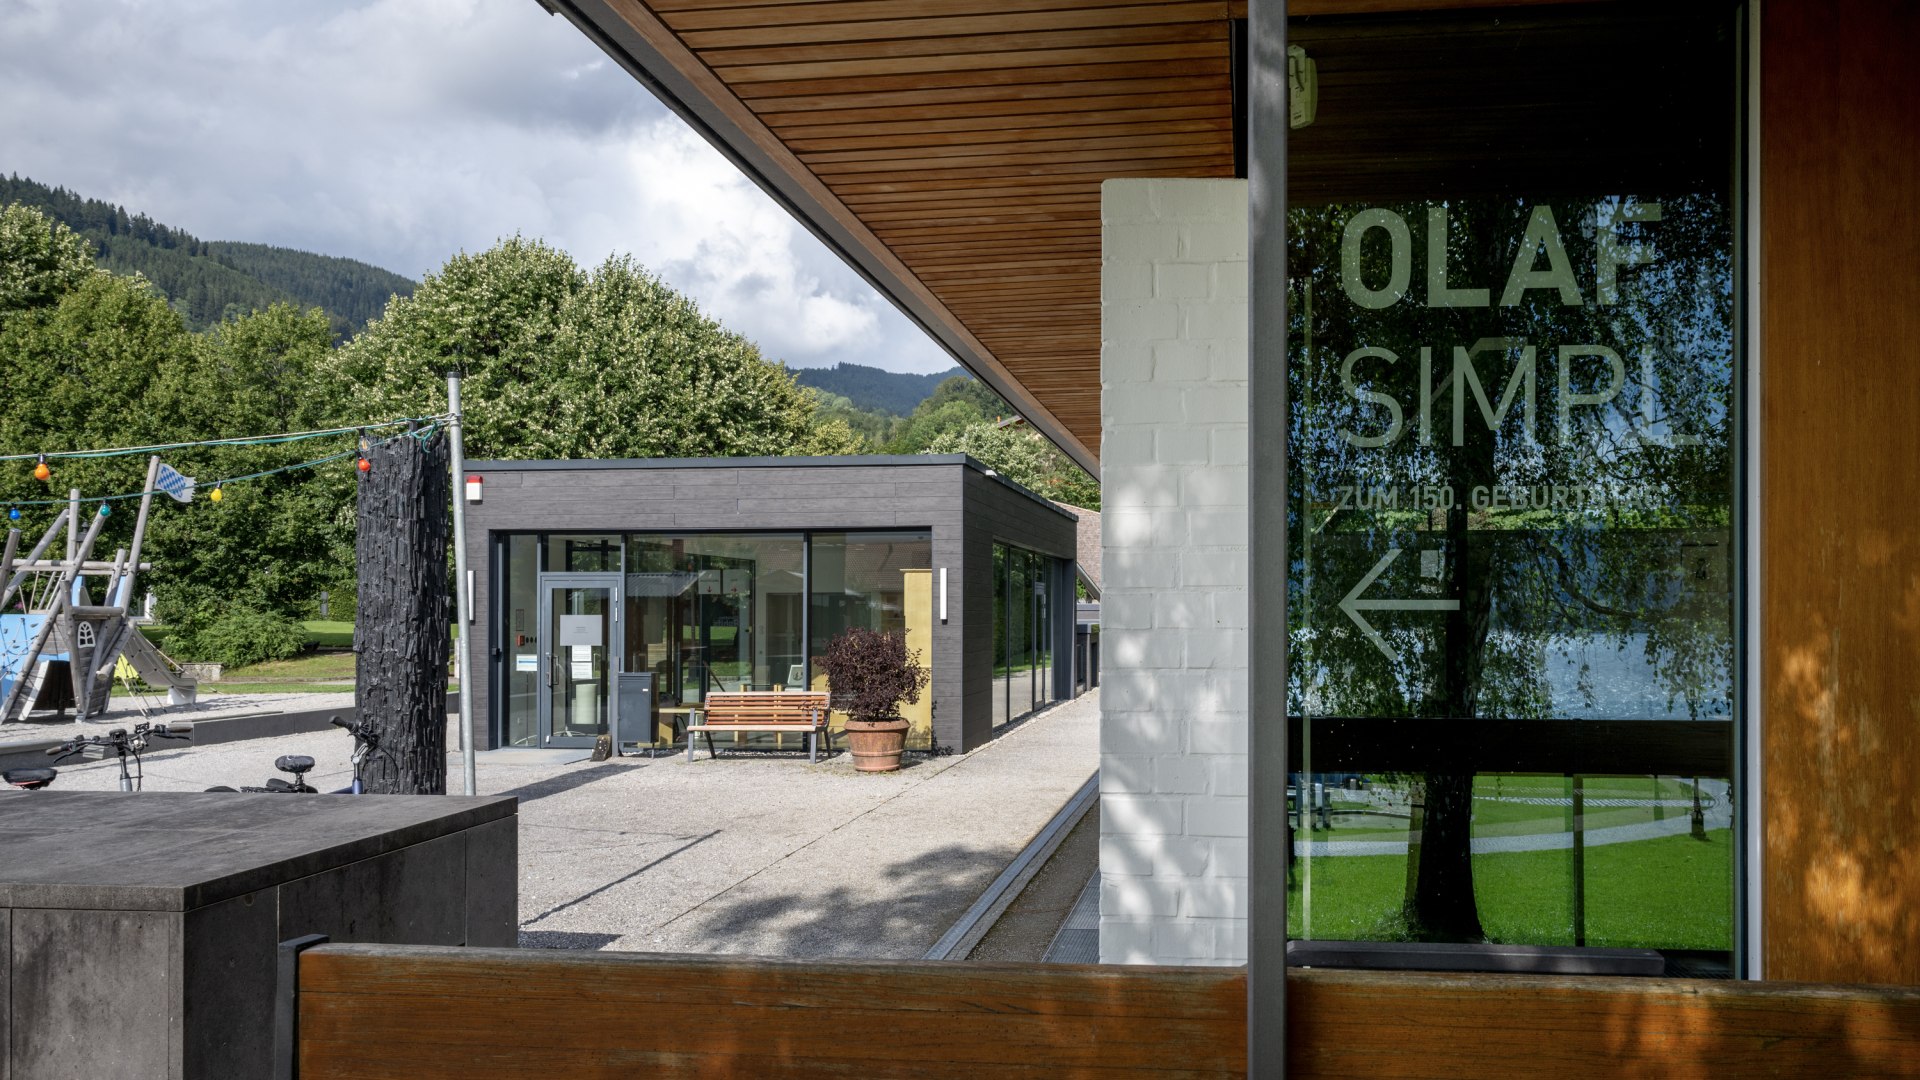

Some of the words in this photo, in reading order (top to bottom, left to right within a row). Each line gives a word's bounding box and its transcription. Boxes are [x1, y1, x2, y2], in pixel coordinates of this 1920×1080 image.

[1341, 203, 1662, 309] OLAF
[1339, 344, 1701, 448] SIMPL
[1339, 485, 1398, 510] ZUM
[1409, 485, 1462, 510] 150.
[1471, 485, 1662, 510] GEBURTSTAG
